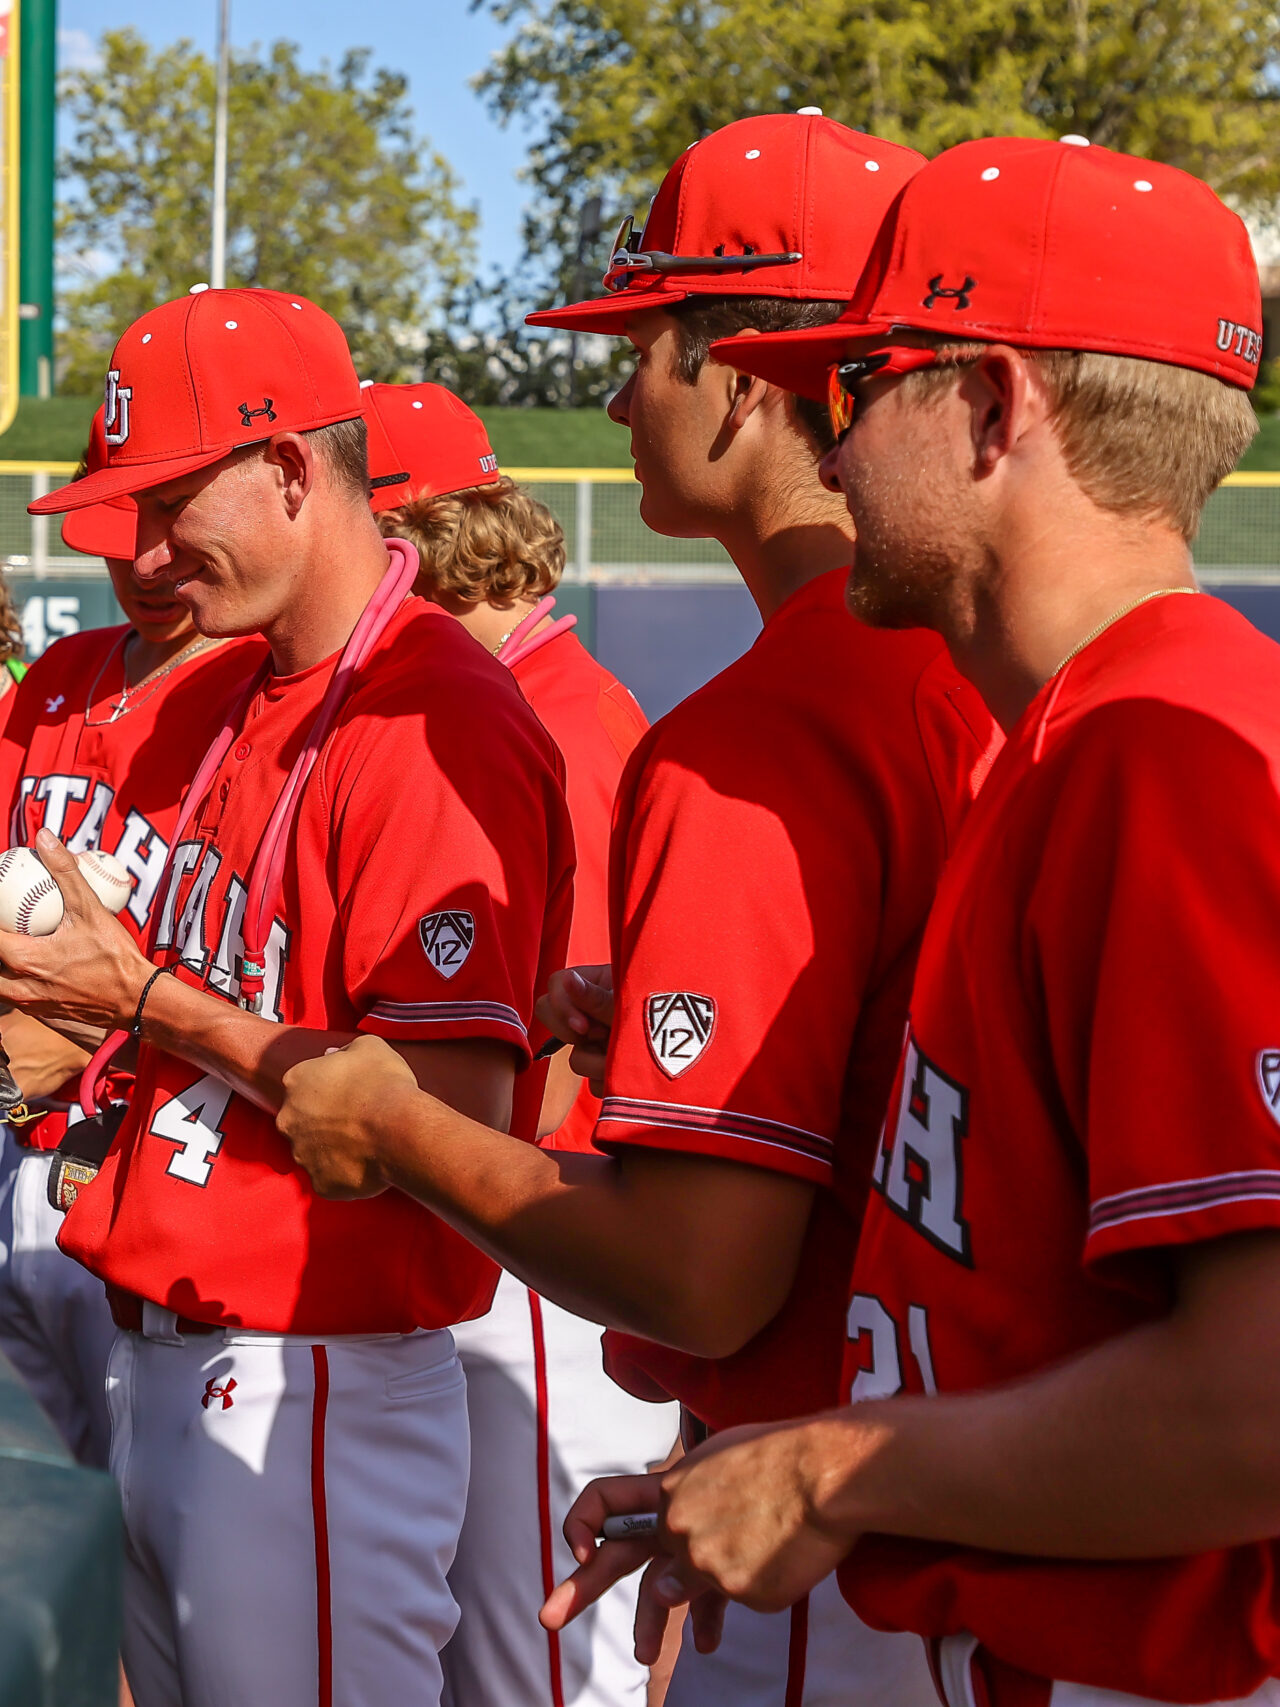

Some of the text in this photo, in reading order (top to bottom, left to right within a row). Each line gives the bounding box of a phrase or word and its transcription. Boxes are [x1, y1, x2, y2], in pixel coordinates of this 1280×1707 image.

[421, 912, 473, 954] PAC
[434, 940, 462, 966] 12
[649, 994, 713, 1044] PAC
[660, 1028, 694, 1058] 12
[148, 1073, 226, 1188] 4
